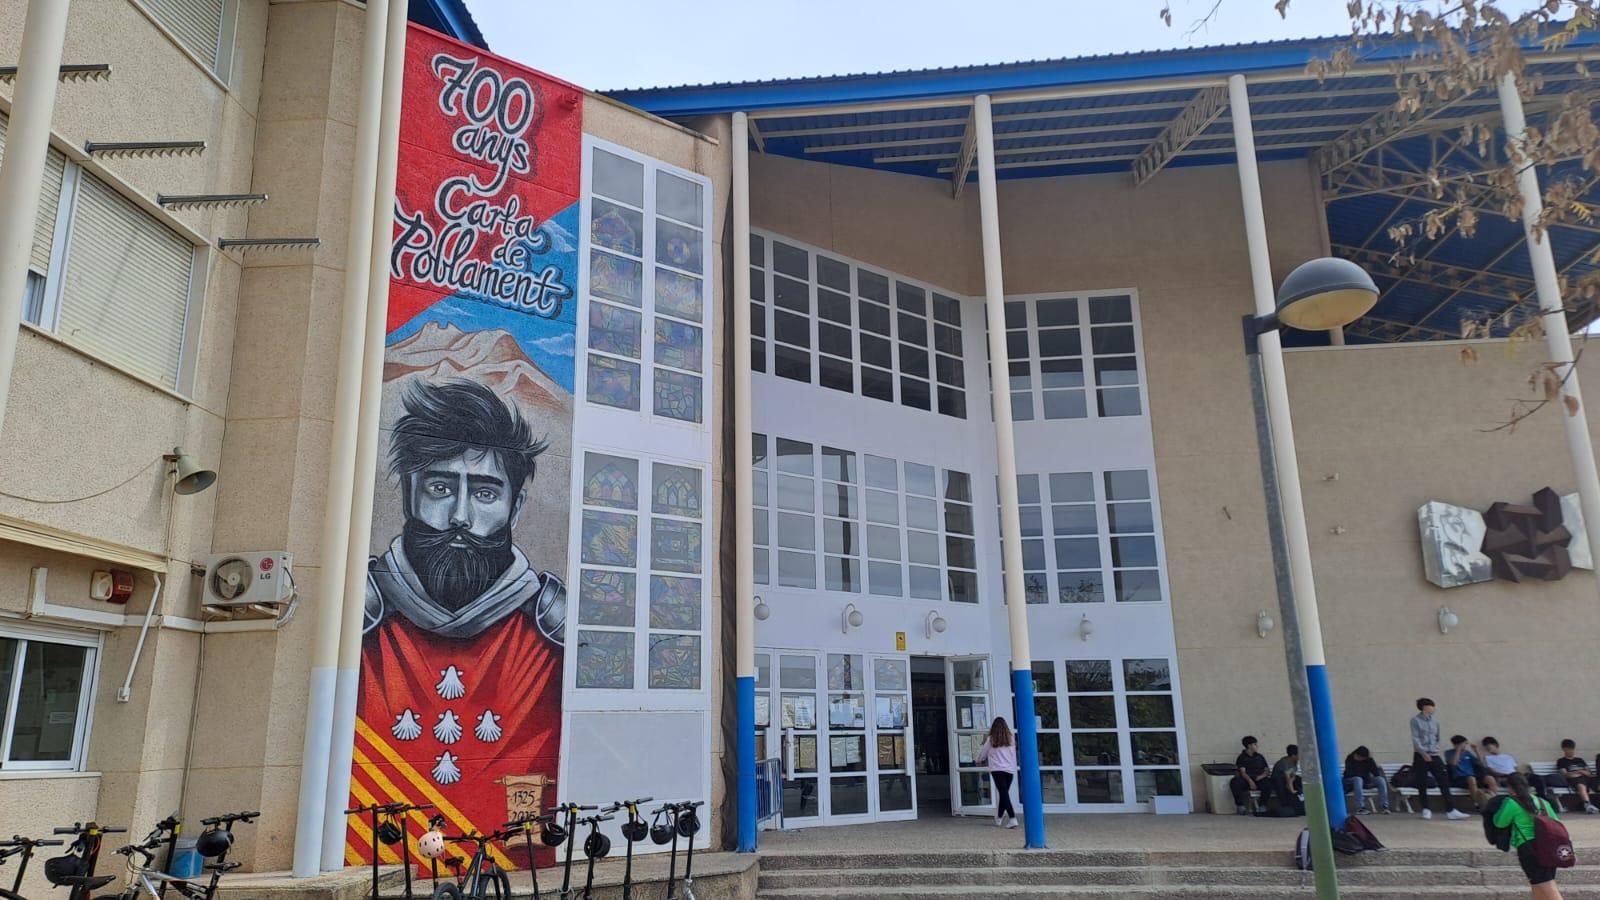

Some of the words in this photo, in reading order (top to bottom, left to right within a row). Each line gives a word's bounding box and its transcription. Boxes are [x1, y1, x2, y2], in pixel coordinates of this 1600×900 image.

[432, 54, 534, 136] 700
[455, 126, 529, 194] anys
[438, 179, 541, 244] Carta
[391, 202, 565, 310] Poblament
[492, 237, 525, 267] de
[260, 572, 271, 580] LG
[512, 790, 536, 807] 1325
